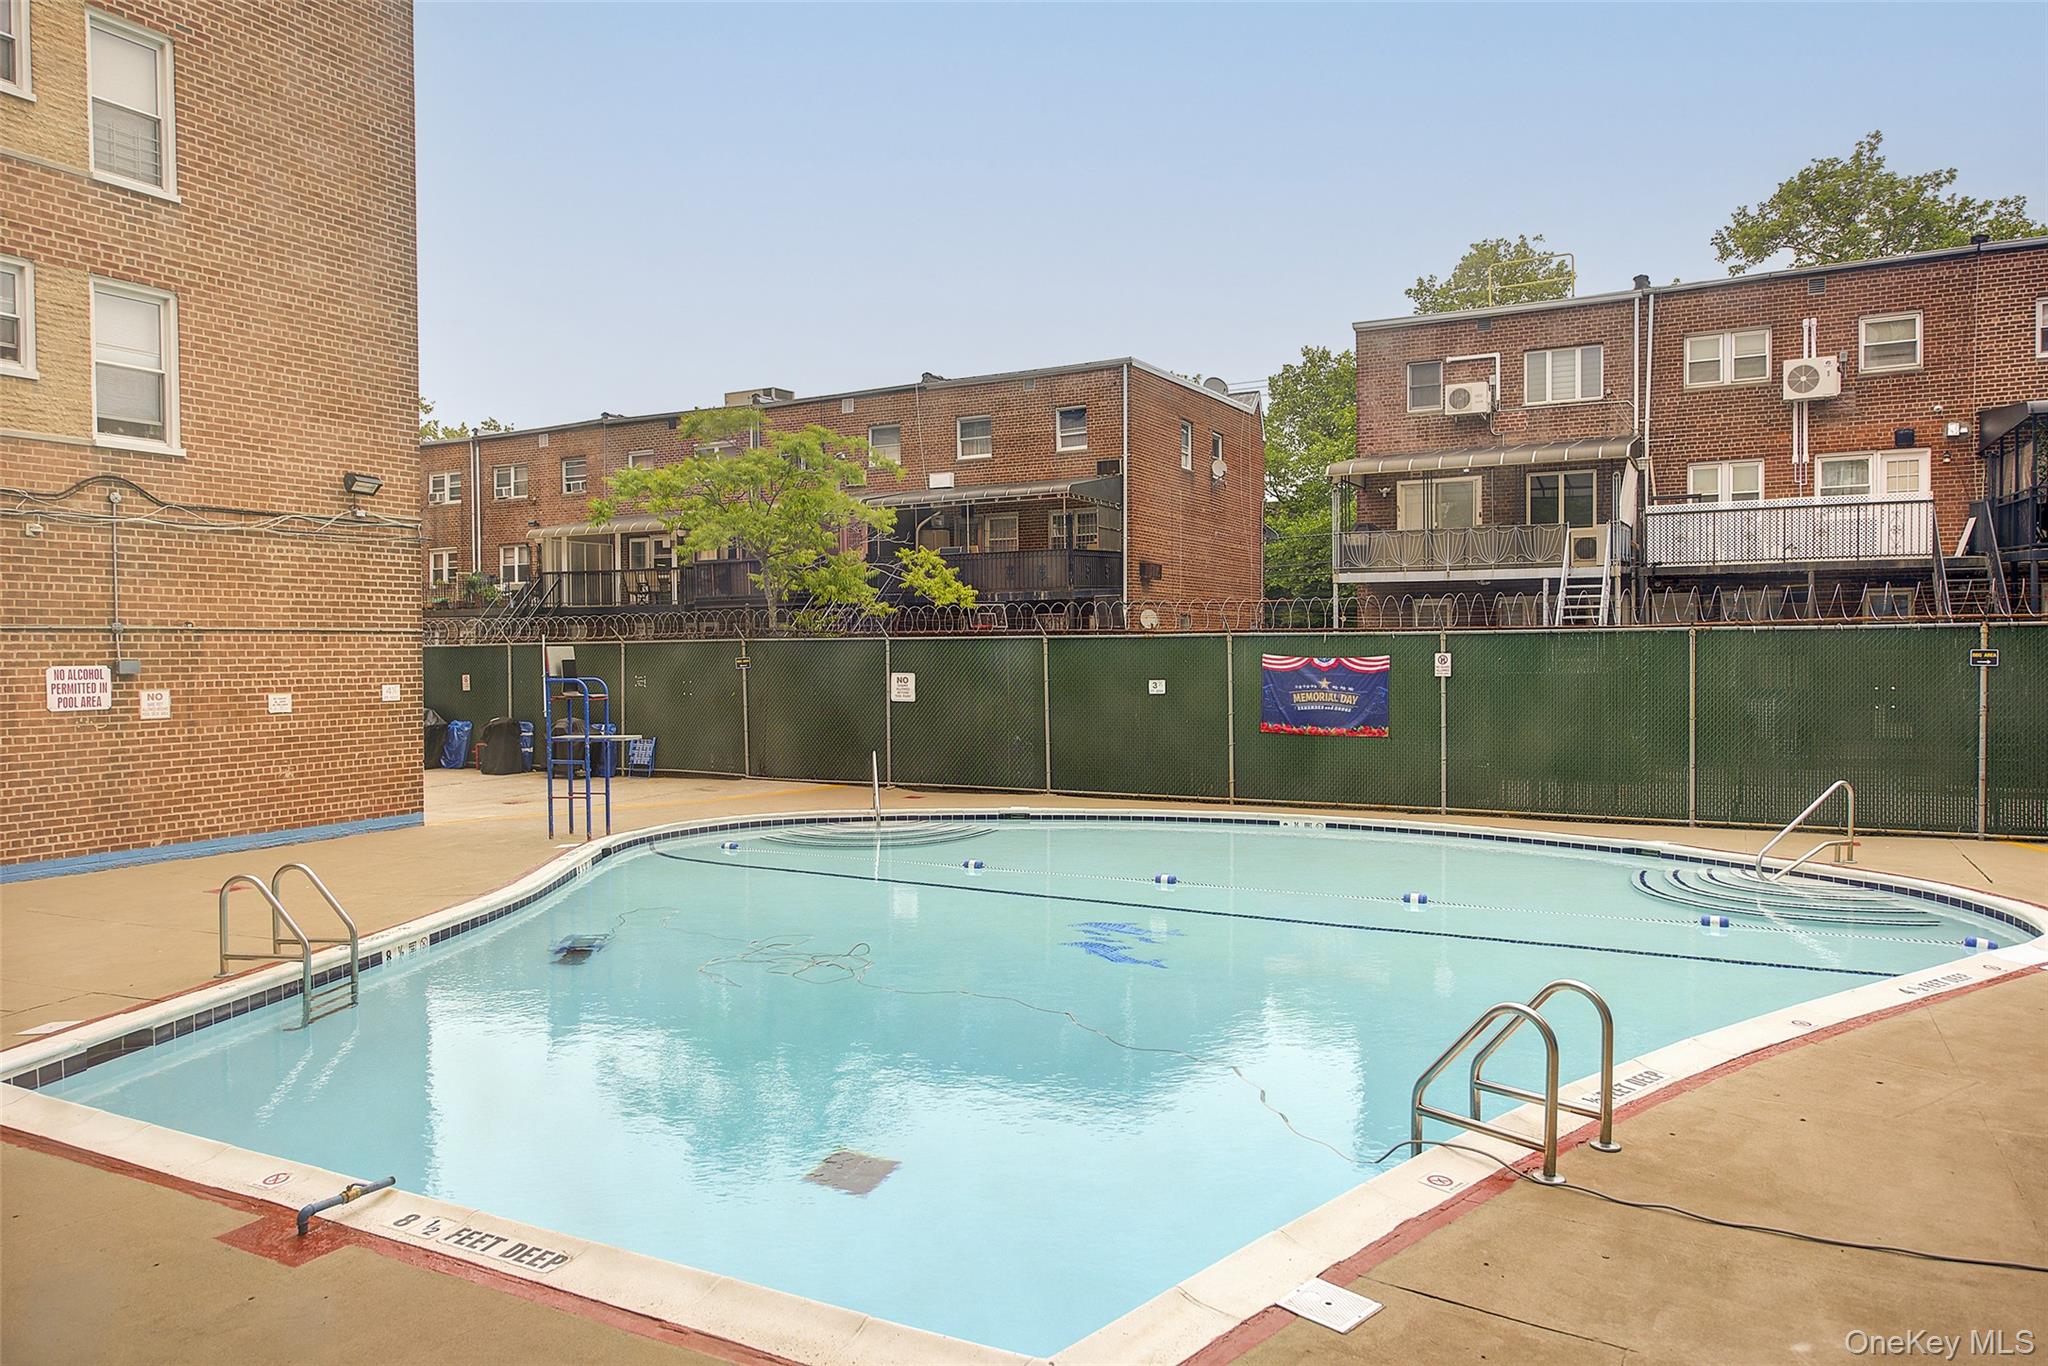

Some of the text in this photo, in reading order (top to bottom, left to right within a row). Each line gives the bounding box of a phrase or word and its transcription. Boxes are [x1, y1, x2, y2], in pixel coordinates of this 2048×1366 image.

[53, 668, 104, 681] NO ALCOHOL
[896, 676, 909, 684] NO
[51, 682, 108, 695] PERMITTED IN
[57, 696, 102, 709] POOL AREA
[147, 692, 163, 701] NO
[1292, 692, 1359, 705] MEMORIAL DAY
[1625, 1070, 1664, 1087] DEEP
[392, 1213, 421, 1227] 8
[443, 1227, 509, 1252] FEET
[498, 1242, 569, 1270] DEEP
